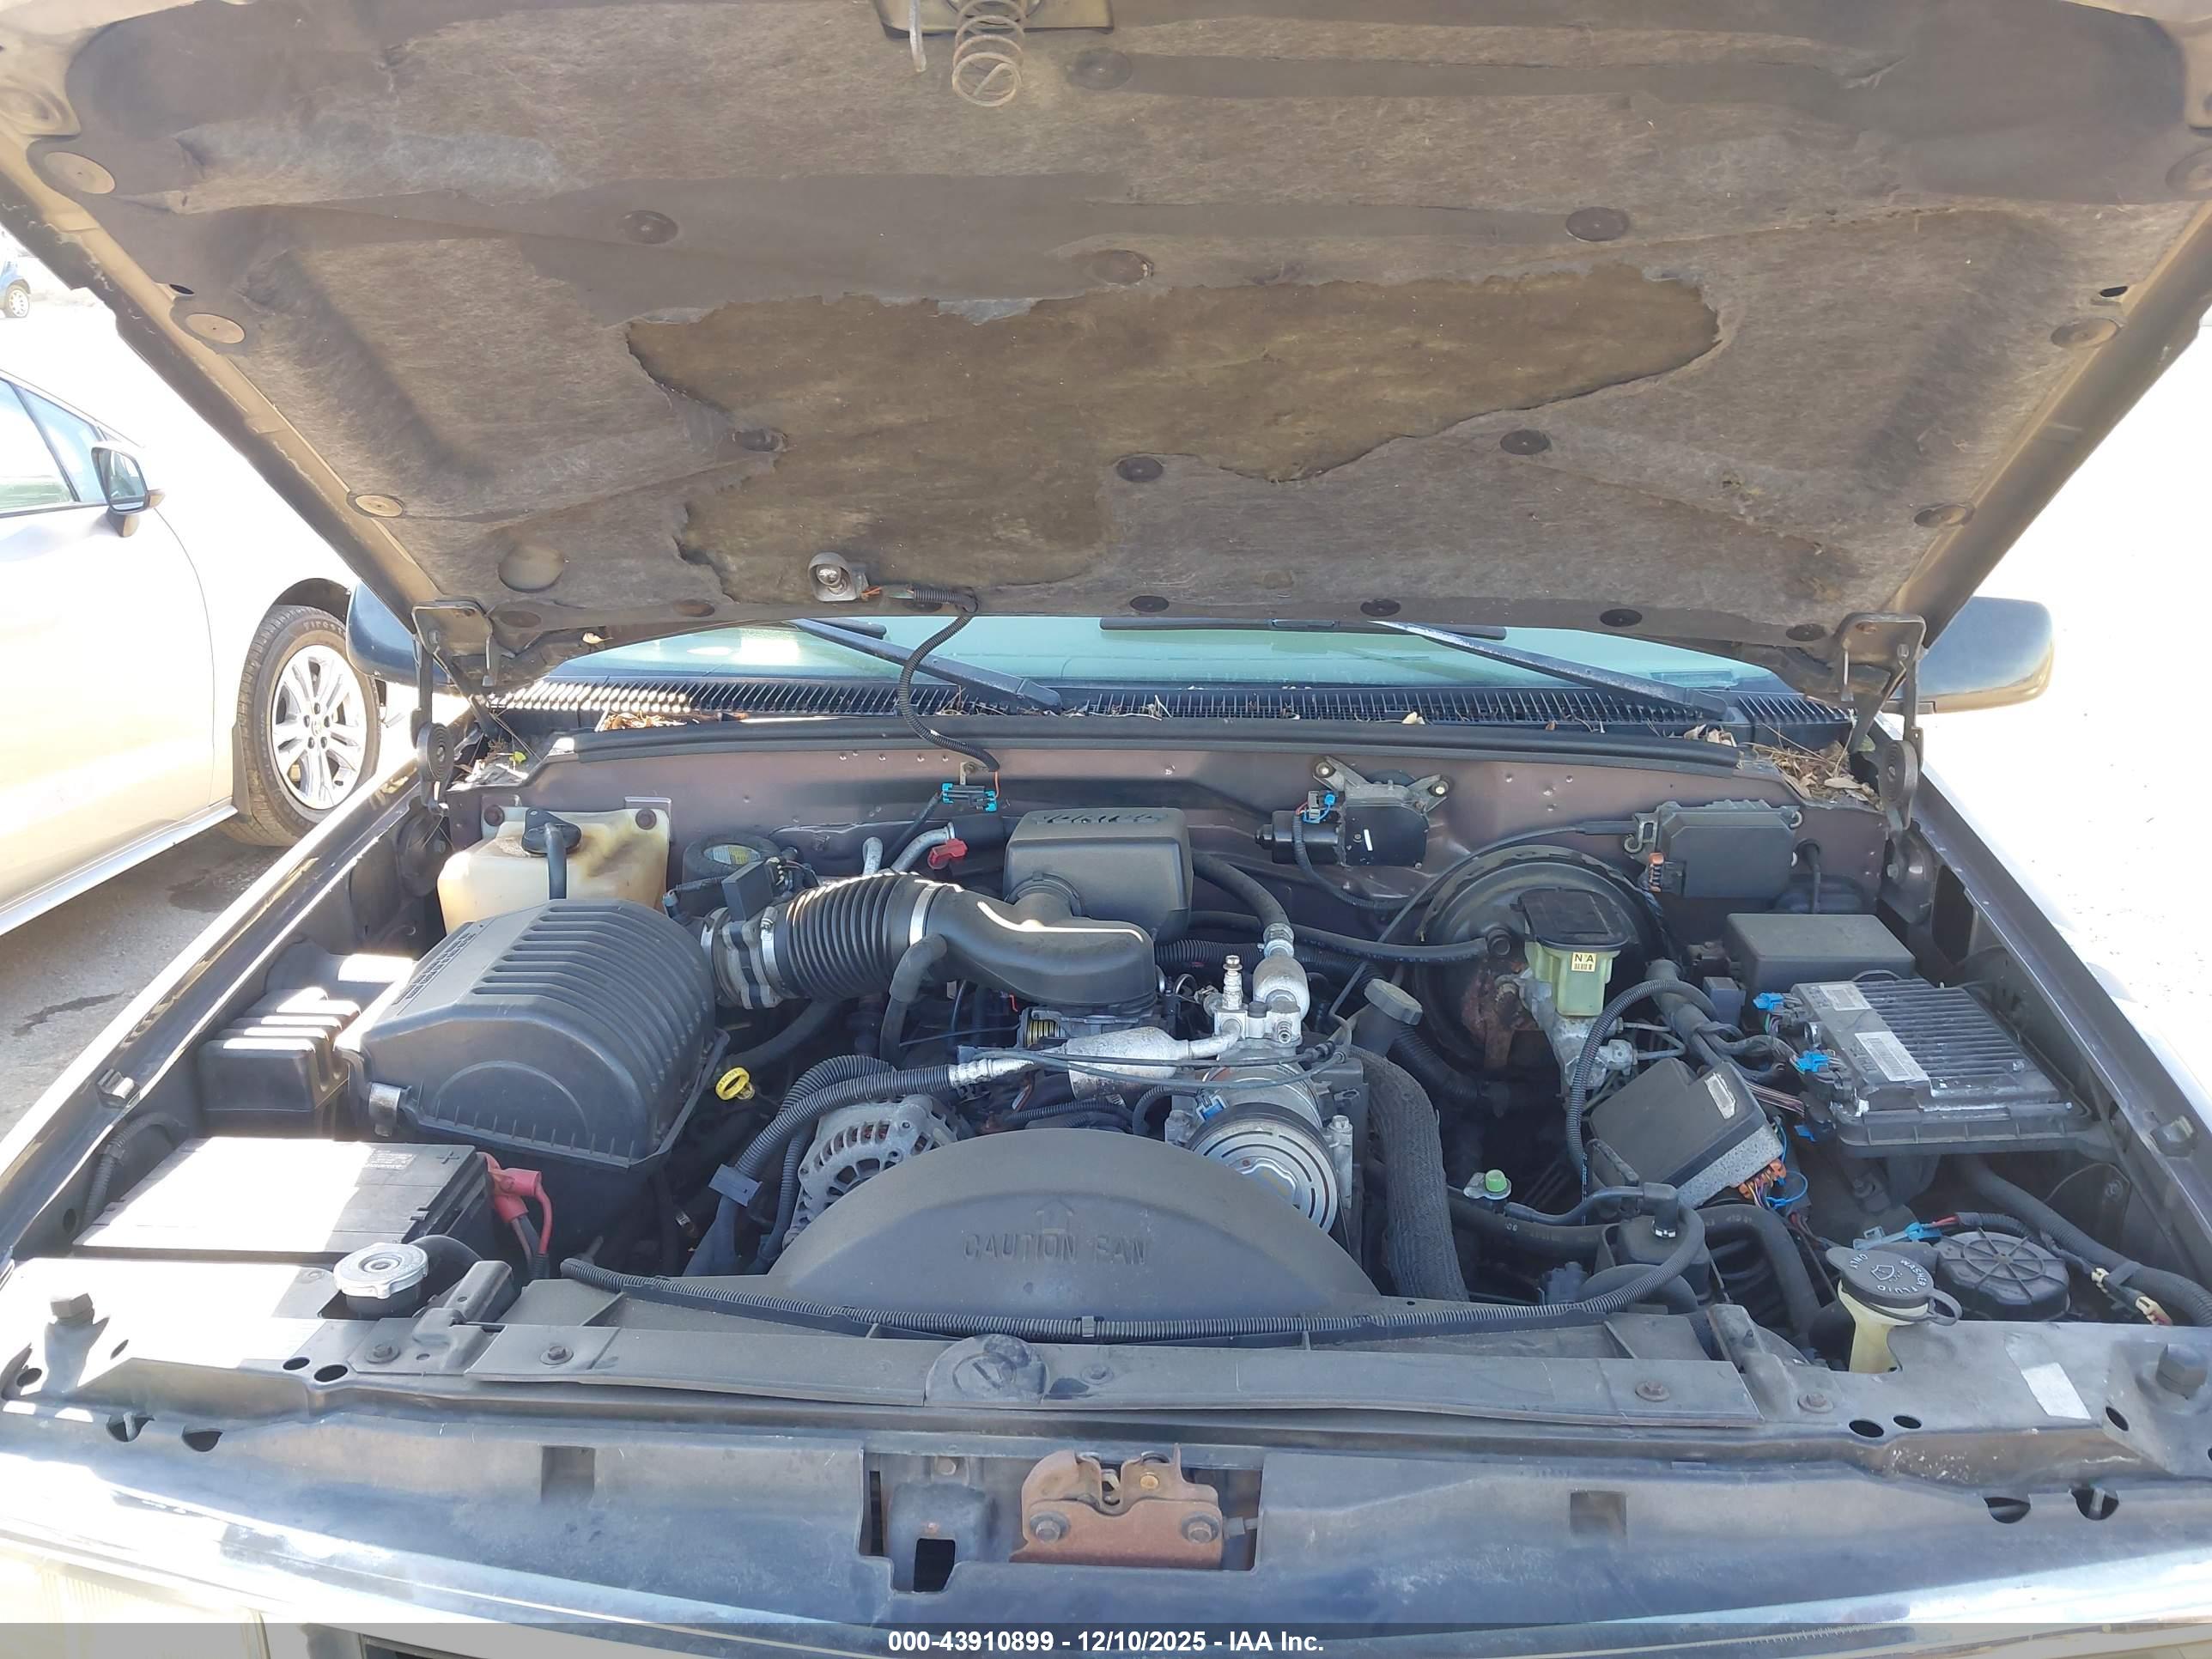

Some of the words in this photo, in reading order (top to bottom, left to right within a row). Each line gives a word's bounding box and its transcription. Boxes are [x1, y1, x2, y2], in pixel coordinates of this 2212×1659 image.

[963, 1233, 1079, 1264] CAUTION
[1093, 1235, 1146, 1265] FAN
[1850, 1253, 1869, 1270] ONLY
[1899, 1259, 1927, 1287] WASHER
[1877, 1285, 1919, 1295] FLUID
